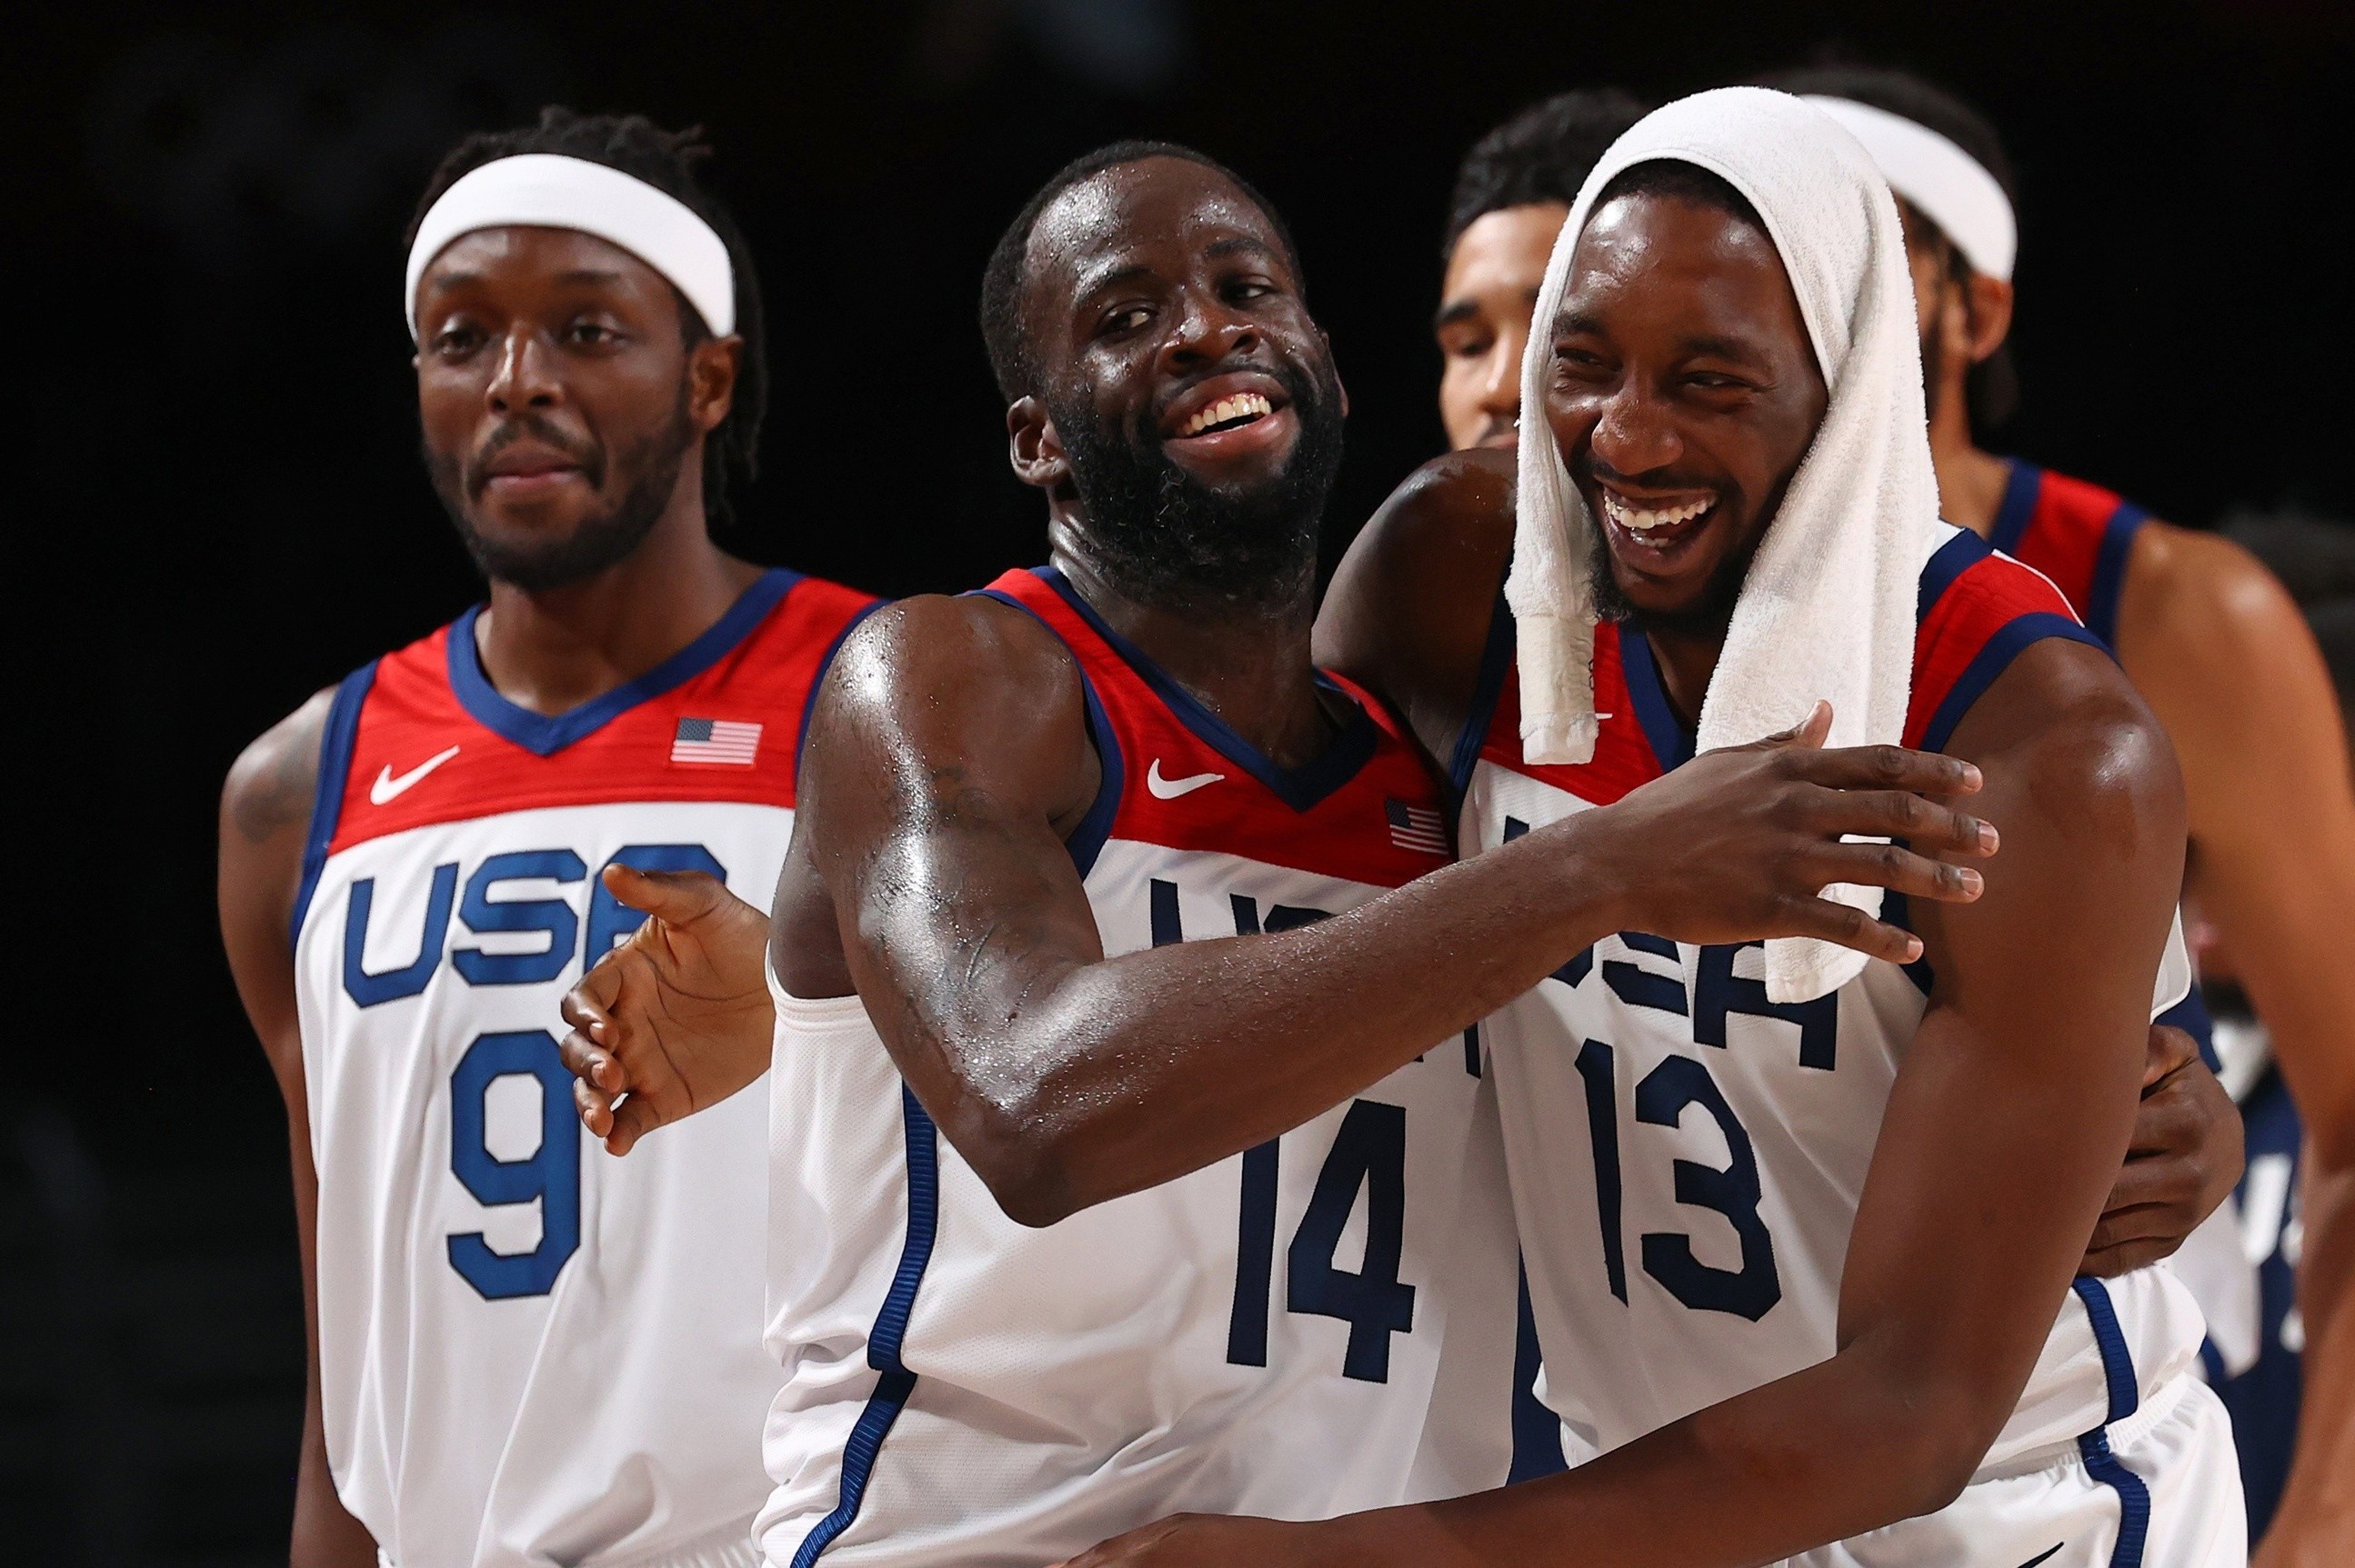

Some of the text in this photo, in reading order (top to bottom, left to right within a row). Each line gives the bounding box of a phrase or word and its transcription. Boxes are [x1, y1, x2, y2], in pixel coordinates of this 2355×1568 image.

[446, 1030, 581, 1301] 9
[1227, 1098, 1416, 1383] 14
[1574, 1037, 1781, 1323] 13
